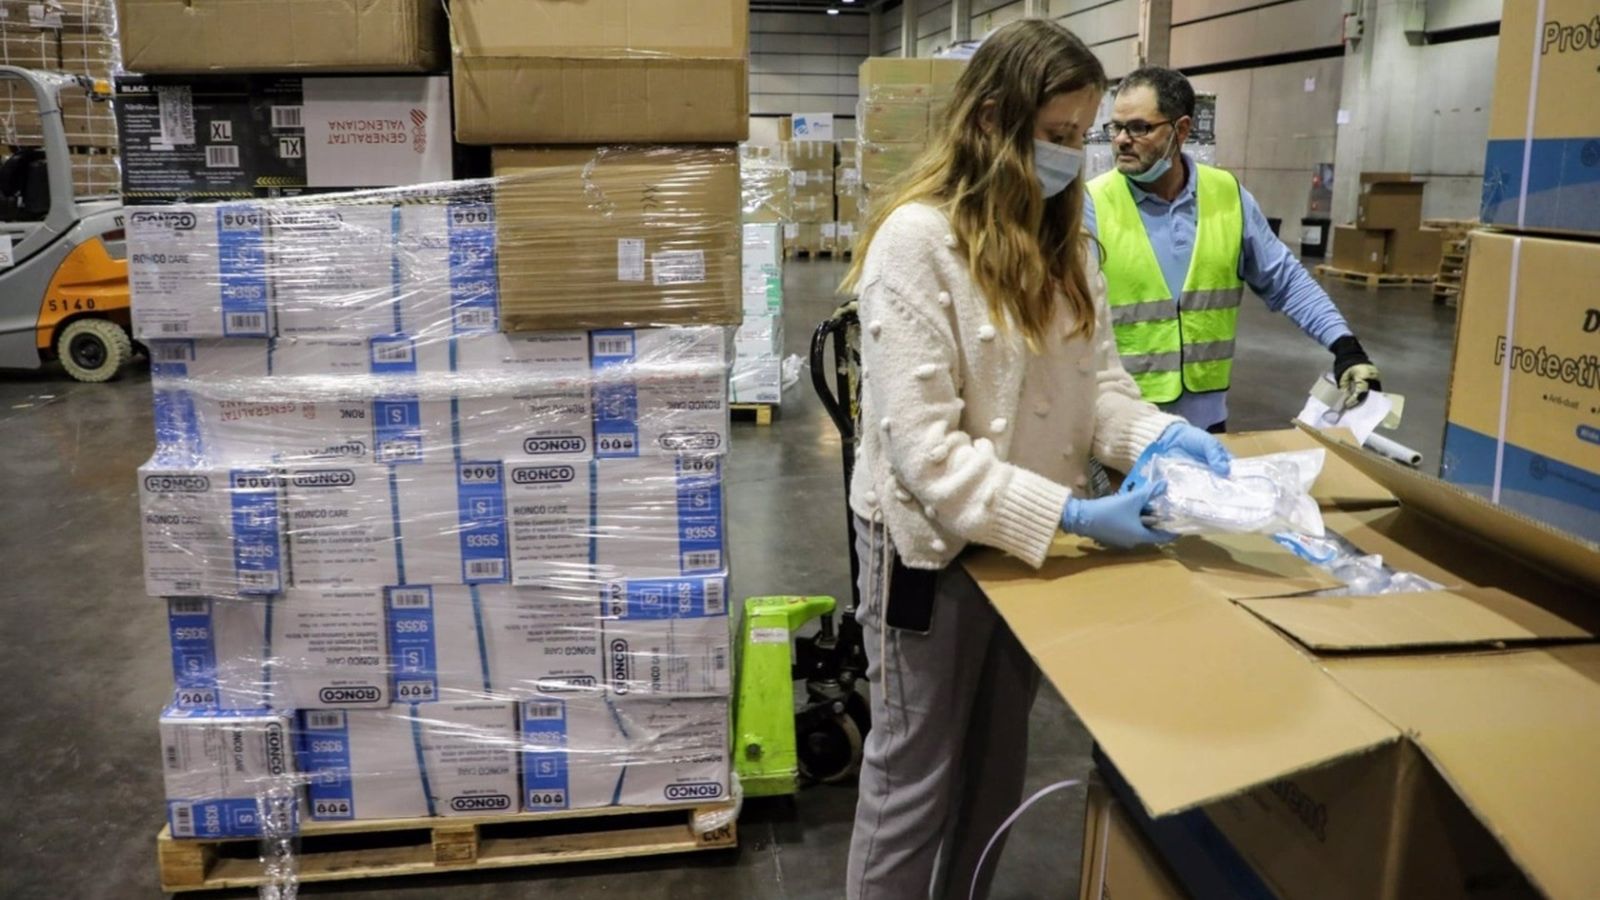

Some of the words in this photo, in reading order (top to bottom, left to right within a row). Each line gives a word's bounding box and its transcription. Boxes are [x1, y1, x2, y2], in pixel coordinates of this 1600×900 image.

[212, 123, 231, 139] XL
[328, 120, 405, 131] VALENCIANA
[327, 132, 407, 144] GENERALITAT
[281, 139, 299, 155] XL
[48, 298, 96, 311] 5140
[221, 402, 296, 421] GENERALITAT
[392, 410, 402, 422] S
[529, 440, 581, 451] RONCO
[298, 473, 350, 484] RONCO
[517, 469, 570, 481] RONCO
[151, 479, 205, 489] RONCO
[694, 494, 705, 506] S
[477, 502, 486, 513] S
[514, 506, 546, 515] RONCO
[295, 509, 327, 519] RONCO
[328, 509, 349, 518] CARE
[685, 527, 716, 539] 935S
[467, 534, 499, 547] 935S
[679, 582, 692, 612] 935S
[396, 621, 428, 634] 935S
[544, 646, 564, 655] CARE
[565, 647, 596, 656] RONCO
[347, 657, 379, 666] RONCO
[409, 652, 419, 664] S
[188, 659, 199, 671] S
[614, 644, 626, 690] RONCO
[324, 689, 376, 701] RONCO
[270, 727, 282, 775] RONCO
[541, 761, 552, 773] S
[669, 786, 718, 797] RONCO
[456, 797, 506, 809] RONCO
[205, 805, 219, 832] 935S
[239, 814, 253, 823] S
